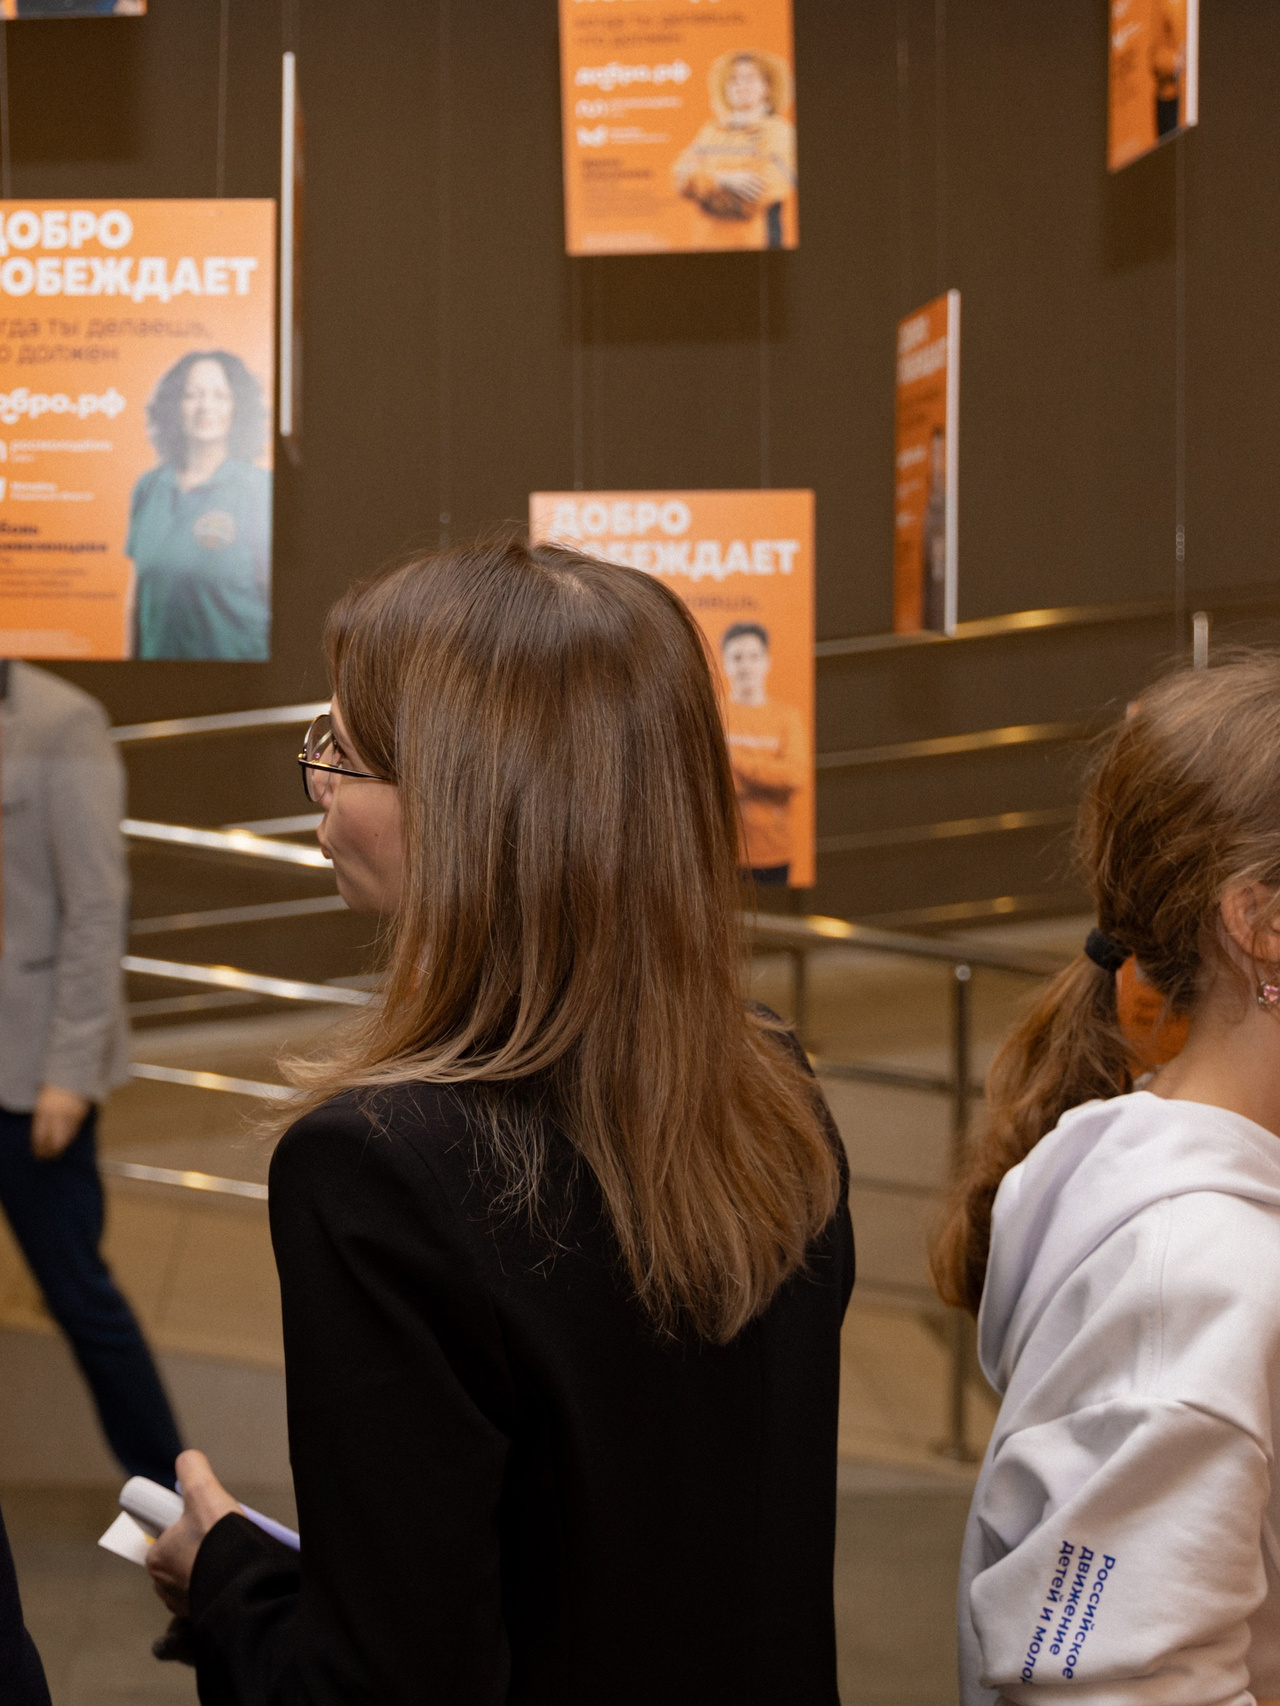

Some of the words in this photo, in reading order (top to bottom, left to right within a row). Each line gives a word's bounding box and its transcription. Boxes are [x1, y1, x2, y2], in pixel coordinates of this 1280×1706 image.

[48, 318, 79, 336] ты
[86, 318, 212, 339] делаешь,
[16, 344, 120, 365] должен
[548, 501, 691, 541] ДОБРО
[1046, 1540, 1075, 1603] детей
[1039, 1606, 1054, 1622] и
[1049, 1546, 1095, 1655] движение
[1062, 1554, 1116, 1680] Российское
